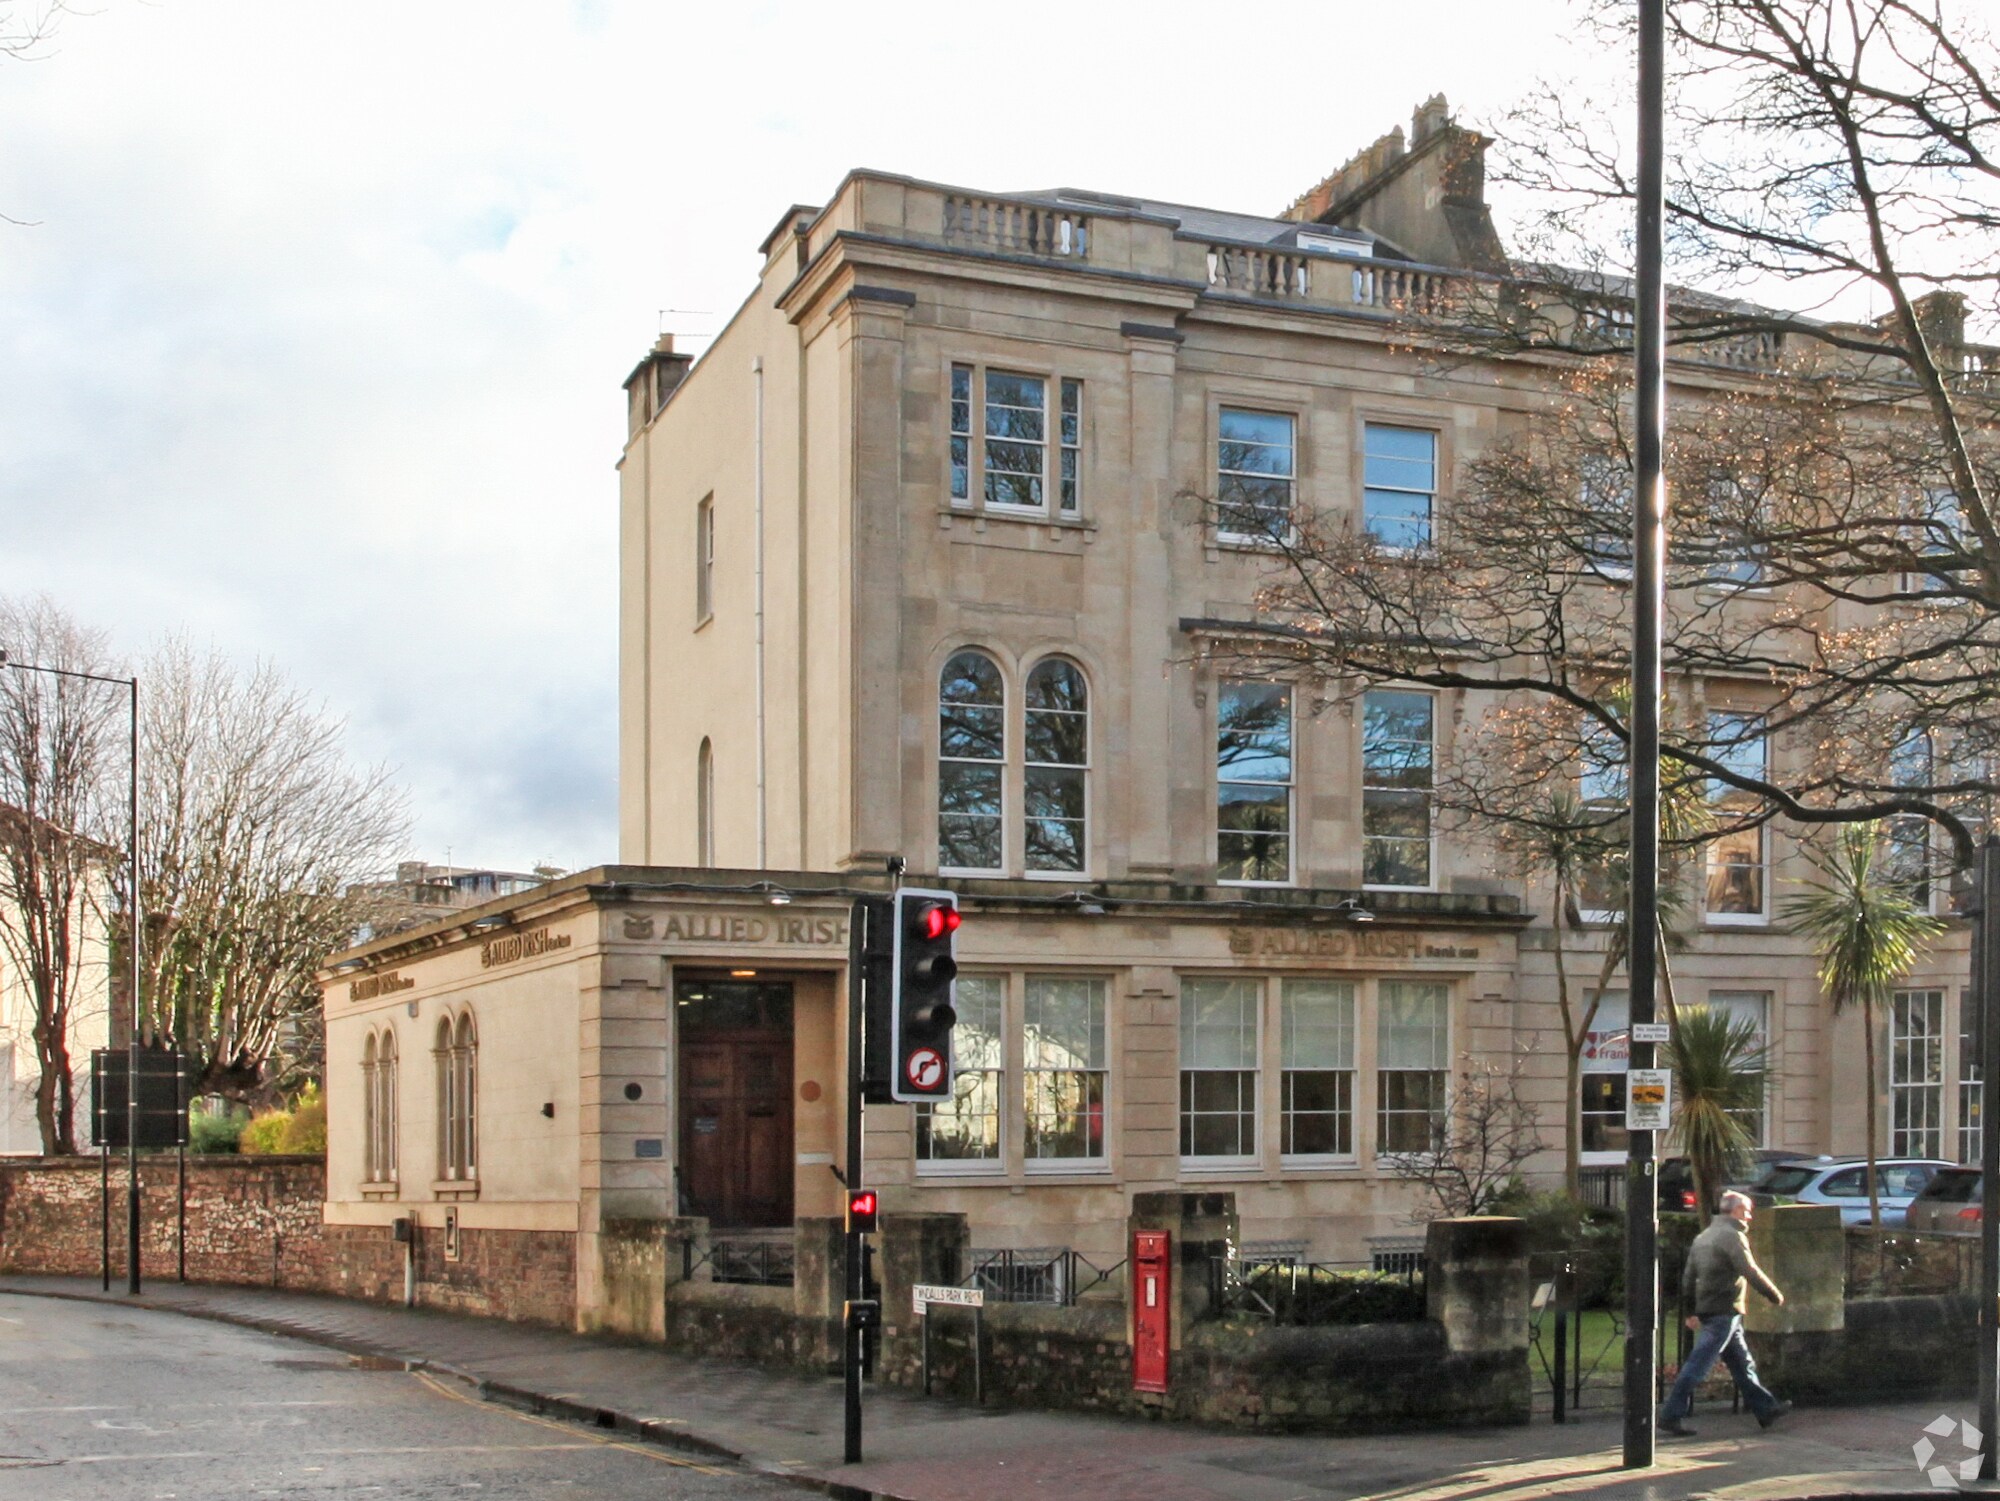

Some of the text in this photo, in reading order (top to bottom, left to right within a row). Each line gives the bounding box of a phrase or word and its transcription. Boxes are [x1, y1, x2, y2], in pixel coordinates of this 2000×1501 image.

[662, 913, 769, 943] ALLIED
[1261, 928, 1348, 956] ALLIED
[1354, 930, 1422, 958] IRISH
[490, 935, 522, 966] ALLIED
[523, 927, 549, 958] IRISH
